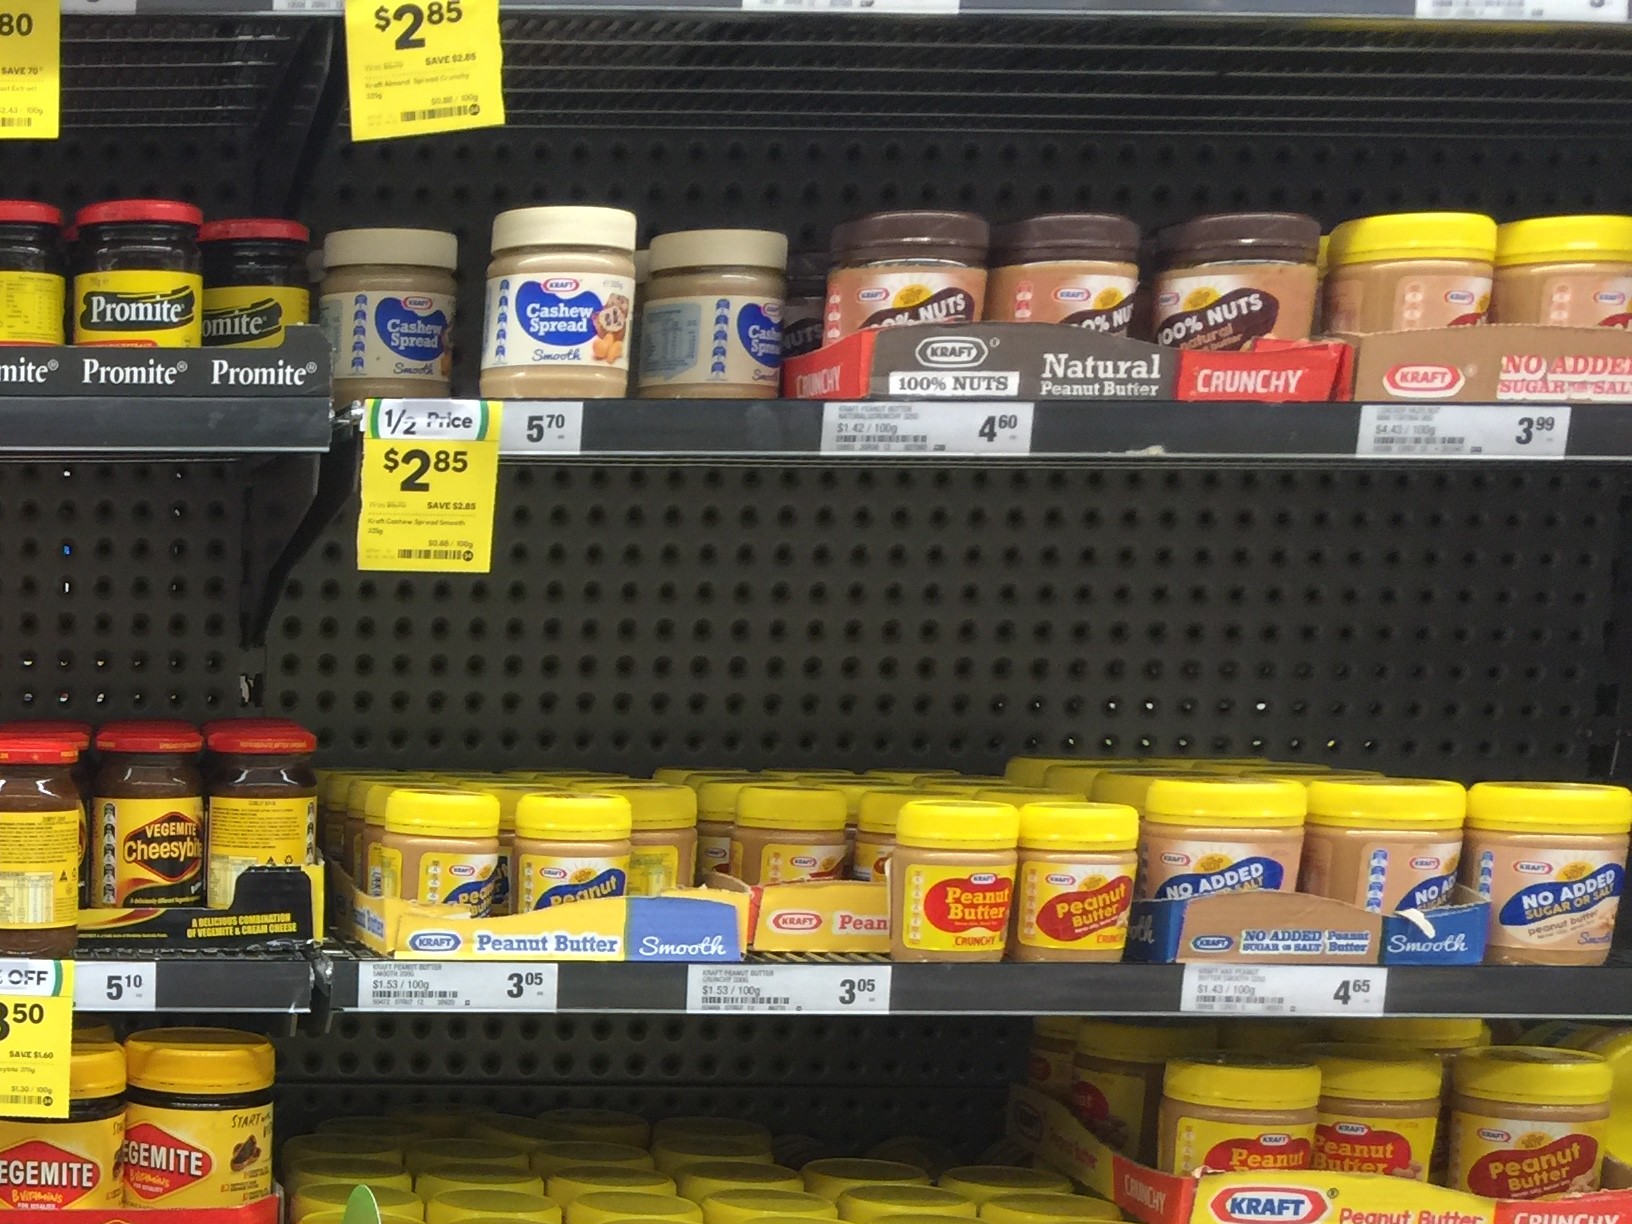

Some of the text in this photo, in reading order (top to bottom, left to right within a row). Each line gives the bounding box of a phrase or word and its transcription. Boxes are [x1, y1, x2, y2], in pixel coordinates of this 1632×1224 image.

[425, 56, 450, 65] SAVE
[548, 281, 575, 289] KRAFT
[92, 296, 180, 323] Promite
[526, 302, 593, 319] Cashew
[530, 317, 589, 335] Spread
[532, 347, 582, 362] Smooth
[930, 344, 974, 359] KRAFT
[82, 360, 178, 386] Promite
[211, 360, 307, 386] Promite
[1041, 354, 1161, 378] Natural
[898, 376, 1009, 392] 100% NUTS
[1196, 368, 1304, 394] CRUNCHY
[1399, 370, 1448, 385] KRAFT
[1040, 380, 1159, 396] Peanut Butter
[427, 502, 451, 510] SAVE
[145, 822, 197, 839] VEGEMITE
[946, 886, 1010, 906] Peanut
[947, 902, 1006, 921] Butter
[192, 913, 291, 927] A DELICIOUS COMBINATION
[187, 929, 197, 938] OF
[198, 926, 233, 938] VEGEMITE
[242, 924, 266, 936] CREAM
[268, 922, 297, 933] CHEESE
[1243, 929, 1322, 943] NO ADDED
[417, 935, 455, 949] KRAFT
[476, 933, 726, 957] Peanut Butter Smooth
[1387, 935, 1469, 955] Smooth
[8, 969, 49, 986] OFF
[373, 980, 398, 989] $1.53
[408, 980, 429, 991] 100g
[1229, 1196, 1305, 1217] KRAFT
